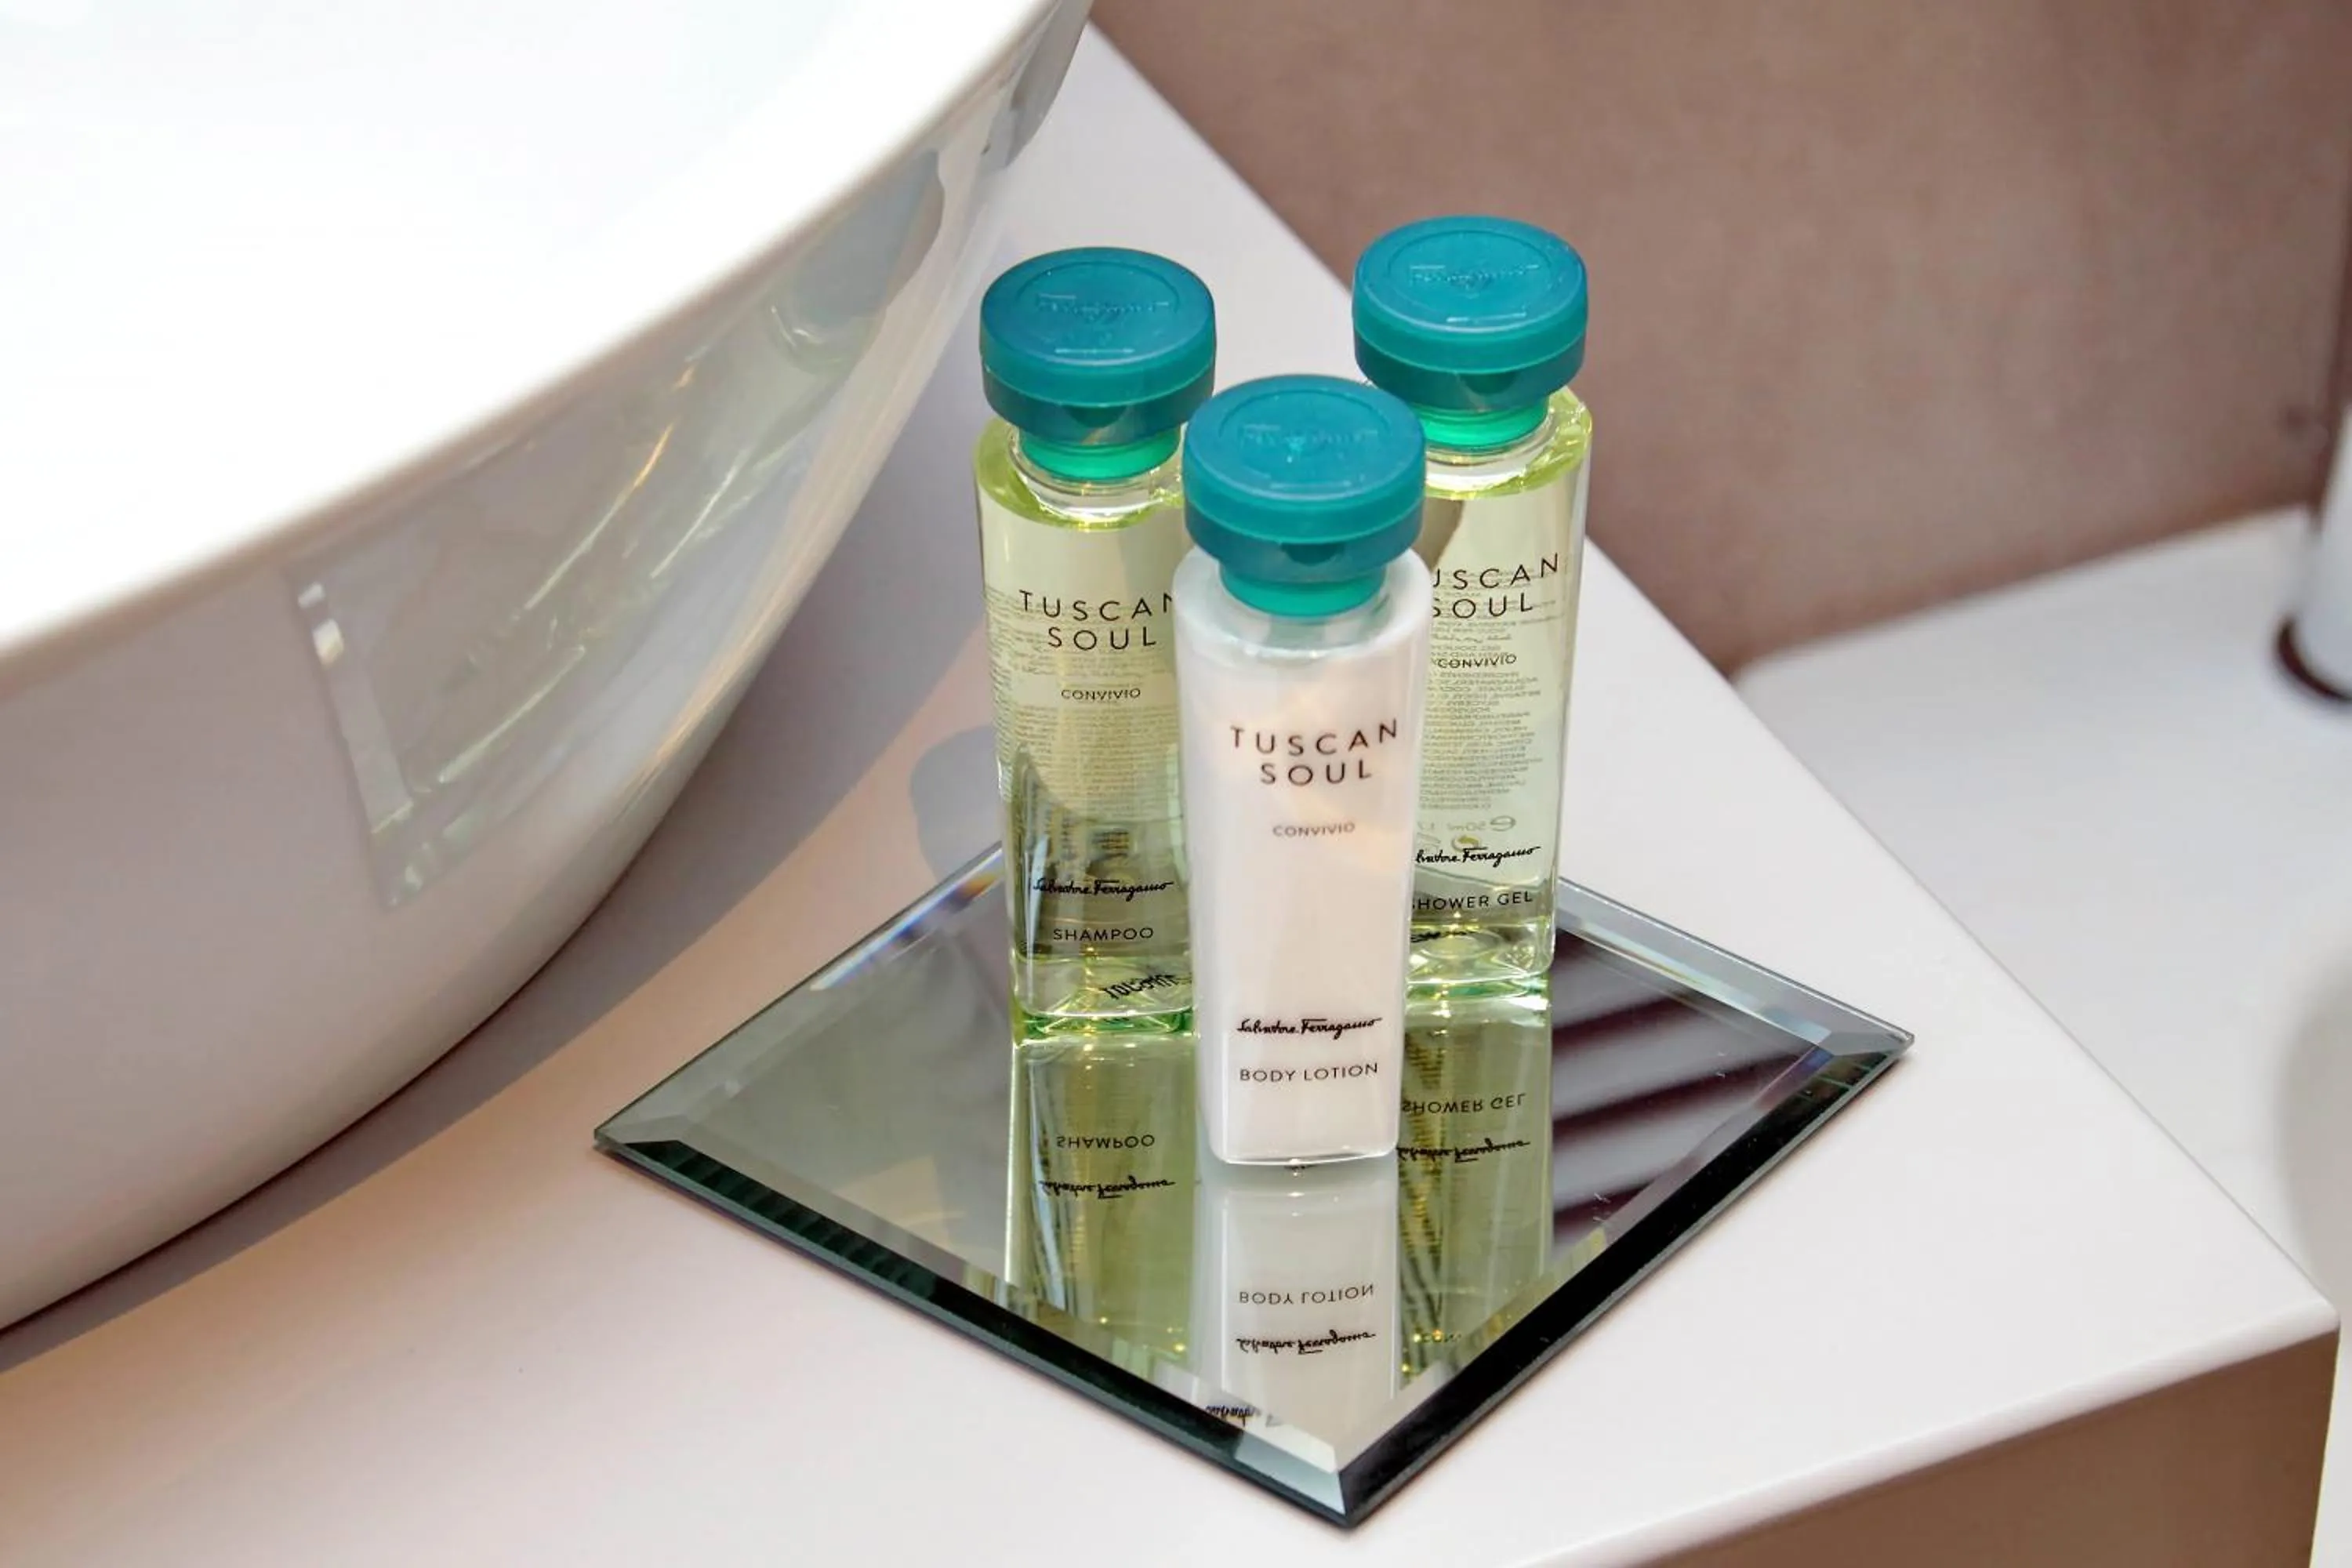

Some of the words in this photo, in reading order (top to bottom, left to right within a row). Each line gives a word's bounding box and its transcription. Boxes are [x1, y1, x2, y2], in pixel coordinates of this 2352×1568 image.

[1433, 553, 1558, 590] SCAN
[1048, 626, 1156, 650] SOUL
[1437, 654, 1517, 669] CONVIVIO
[1061, 688, 1141, 702] CONVIVIO
[1230, 718, 1397, 757] TUSCAN
[1260, 758, 1373, 786] SOUL
[1272, 822, 1356, 837] CONVIVIO
[1462, 846, 1541, 868] Ferragamo
[1094, 879, 1174, 902] Ferragamo
[1413, 895, 1489, 910] HOWER
[1497, 891, 1533, 906] GEL
[1053, 927, 1153, 941] SHAMPOO
[1301, 1018, 1382, 1040] Ferragamo
[1240, 1069, 1295, 1083] BODY
[1304, 1062, 1377, 1081] LOTION
